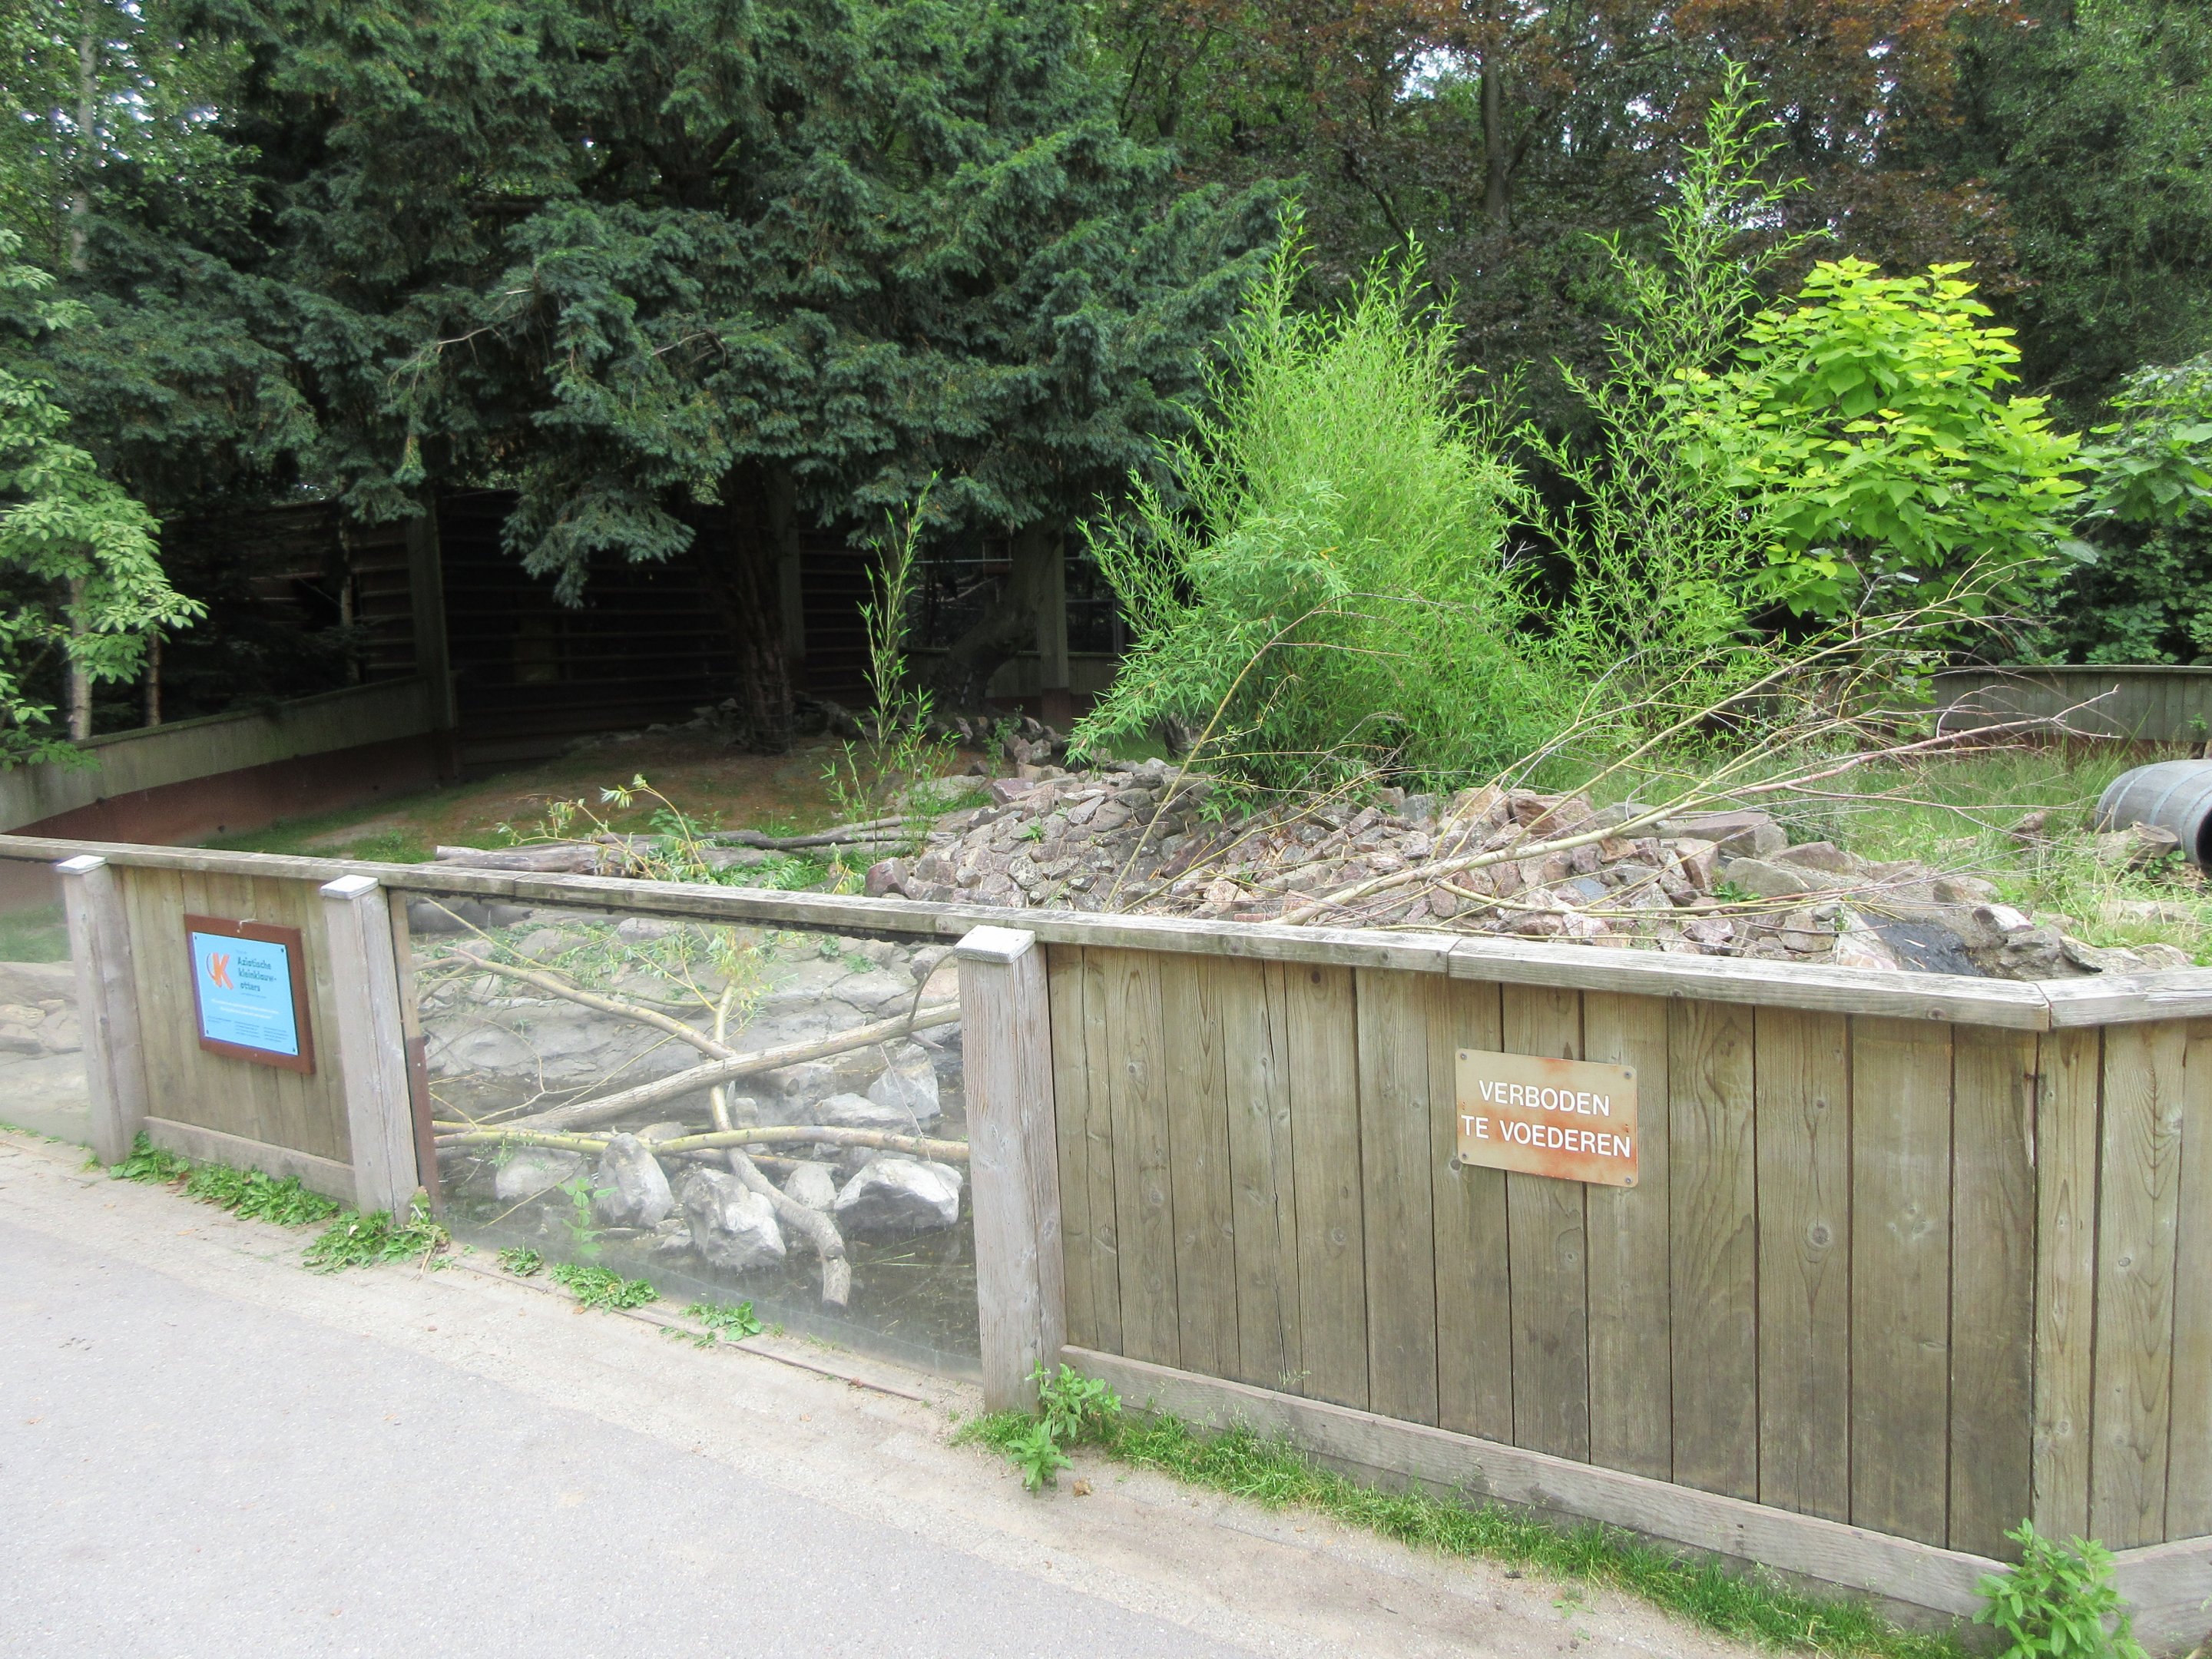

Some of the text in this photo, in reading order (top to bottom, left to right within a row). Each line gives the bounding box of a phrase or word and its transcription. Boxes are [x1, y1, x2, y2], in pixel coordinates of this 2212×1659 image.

[237, 956, 272, 969] Aziatische
[240, 982, 260, 992] otters
[1479, 1079, 1610, 1117] VERBODEN
[1461, 1114, 1631, 1158] TE VOEDEREN
